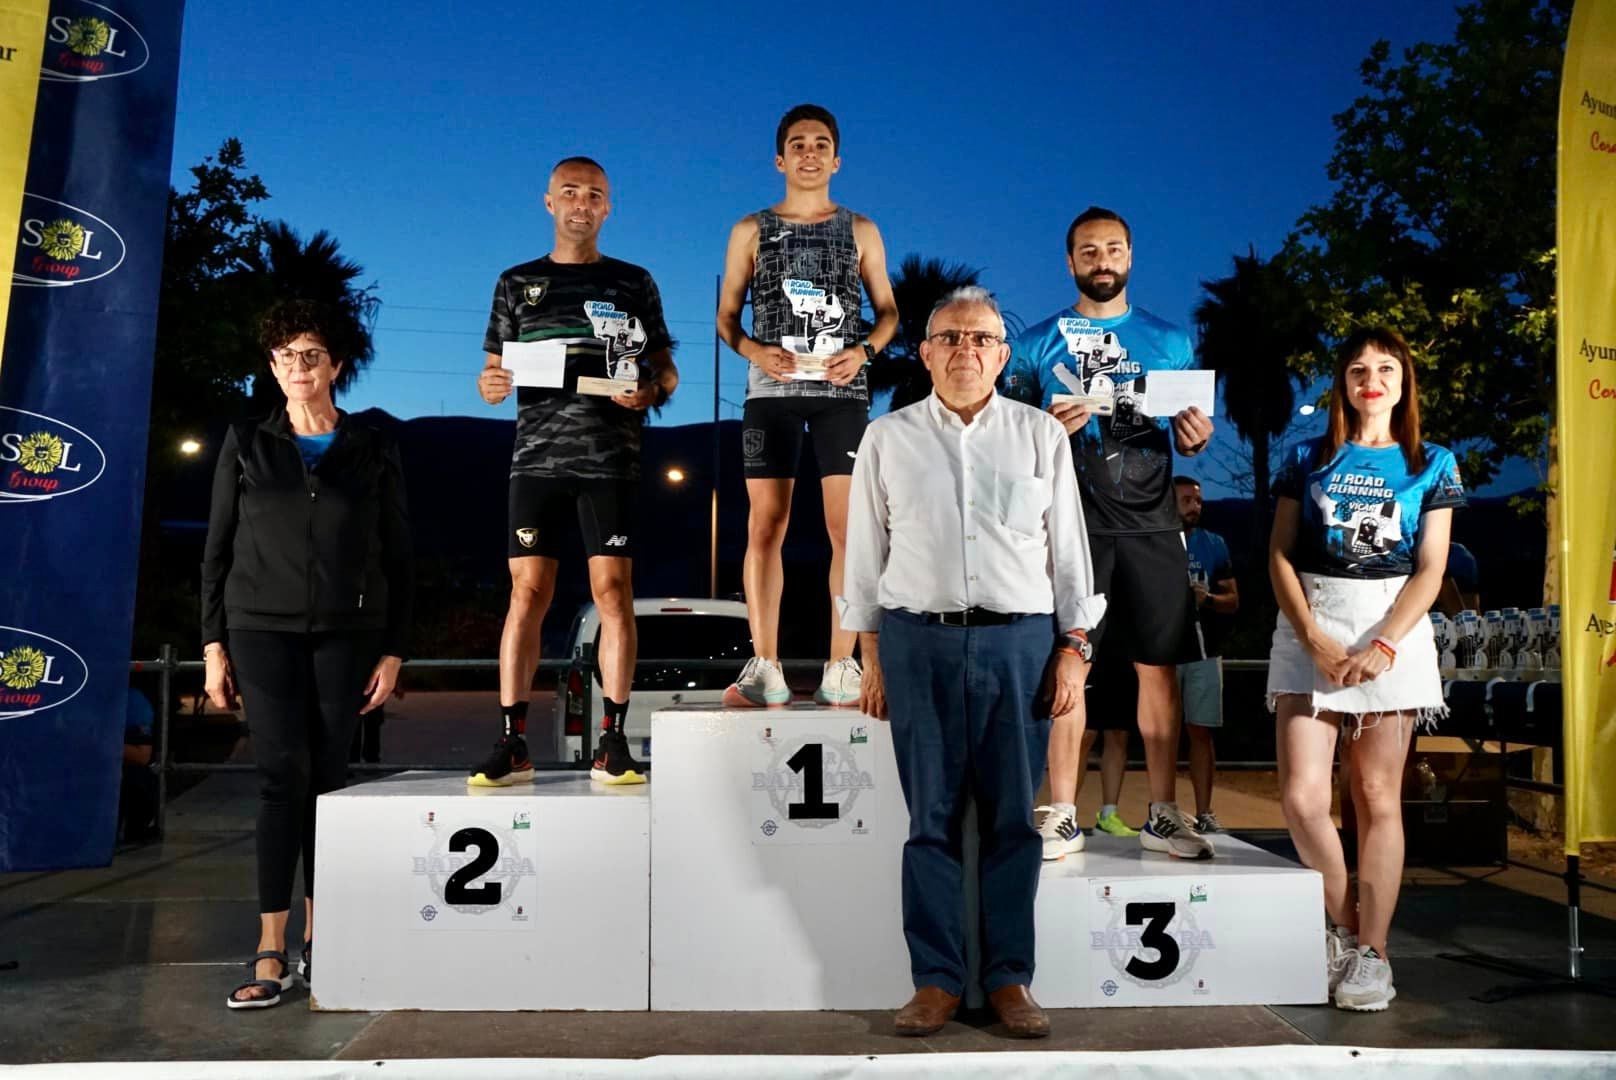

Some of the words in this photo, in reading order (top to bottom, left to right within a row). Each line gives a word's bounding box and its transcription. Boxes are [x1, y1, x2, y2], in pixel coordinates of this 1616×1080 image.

[1327, 483, 1394, 499] RUNNING
[1343, 473, 1385, 488] ROAD
[786, 743, 840, 820] 1
[445, 827, 502, 905] 2
[1125, 902, 1180, 981] 3
